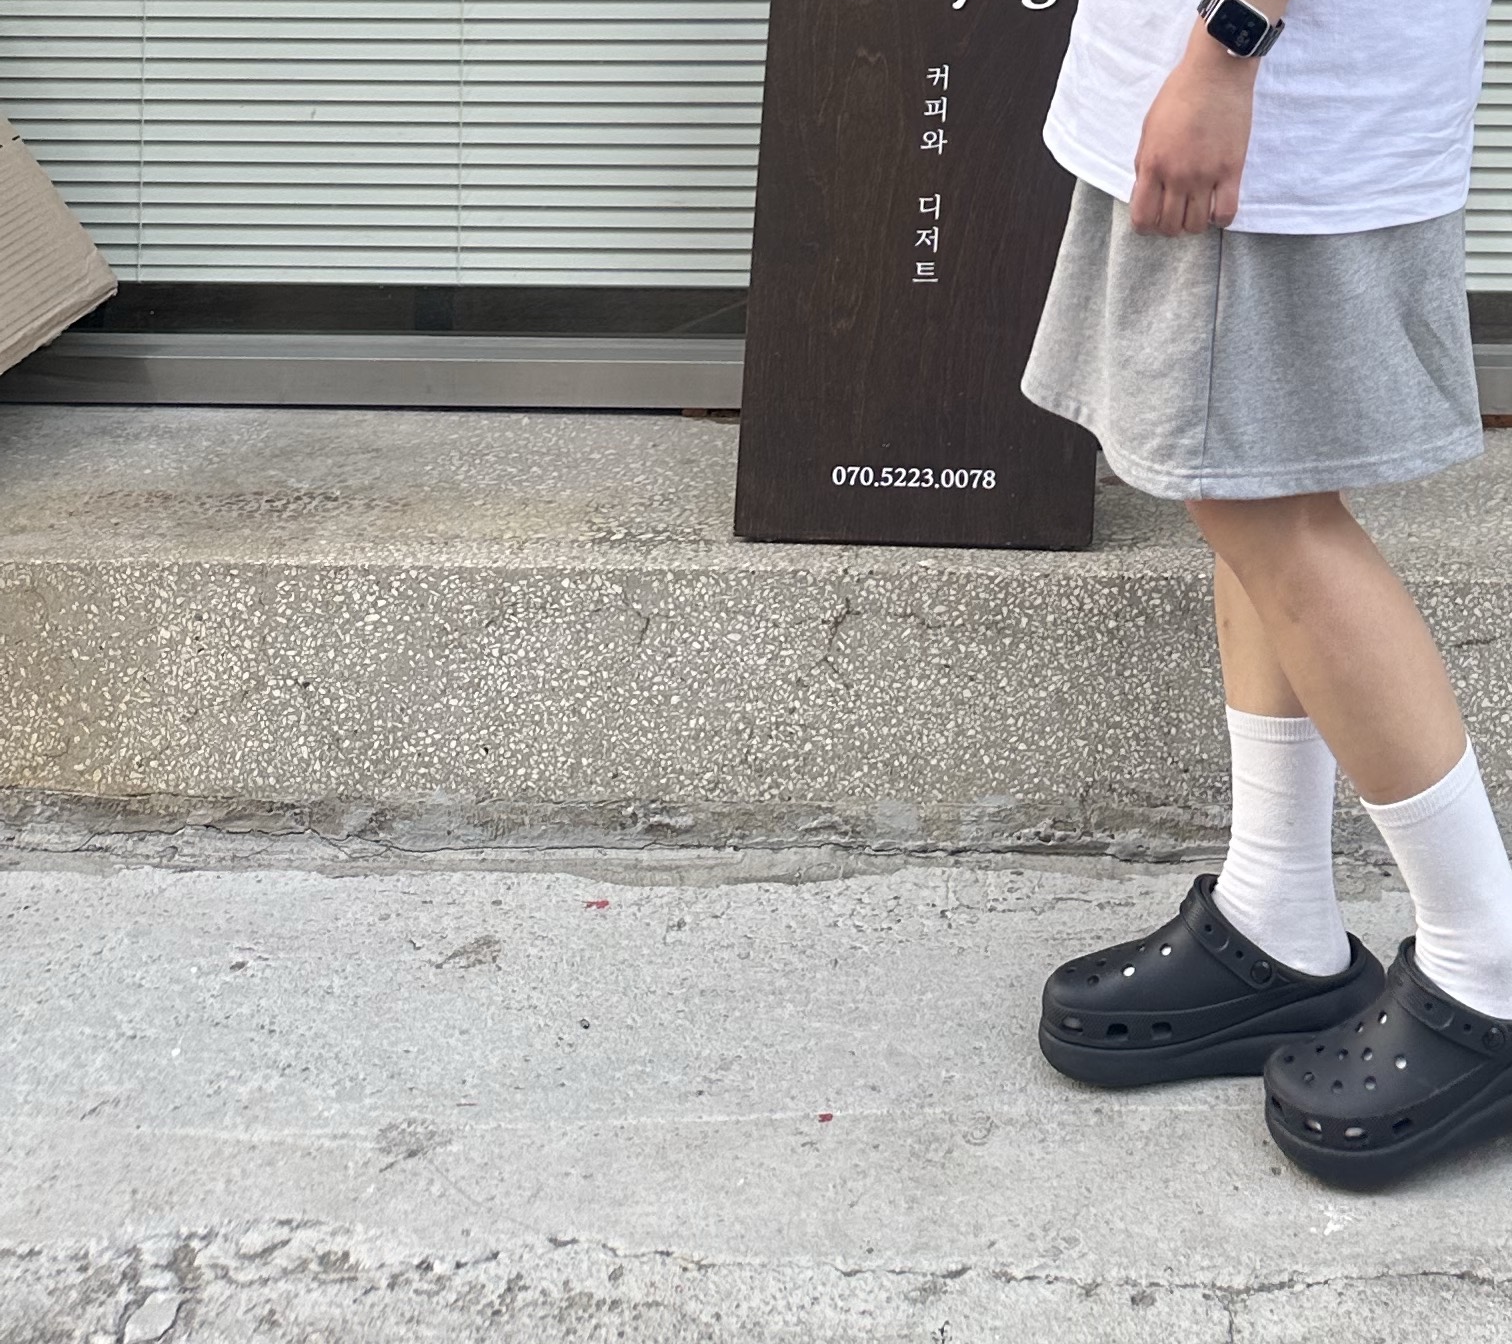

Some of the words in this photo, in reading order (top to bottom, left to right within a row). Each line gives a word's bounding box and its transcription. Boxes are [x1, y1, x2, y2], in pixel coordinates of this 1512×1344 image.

[919, 63, 951, 156] 커피와
[911, 193, 942, 284] 디저트
[831, 465, 996, 490] 070.5223.0078
